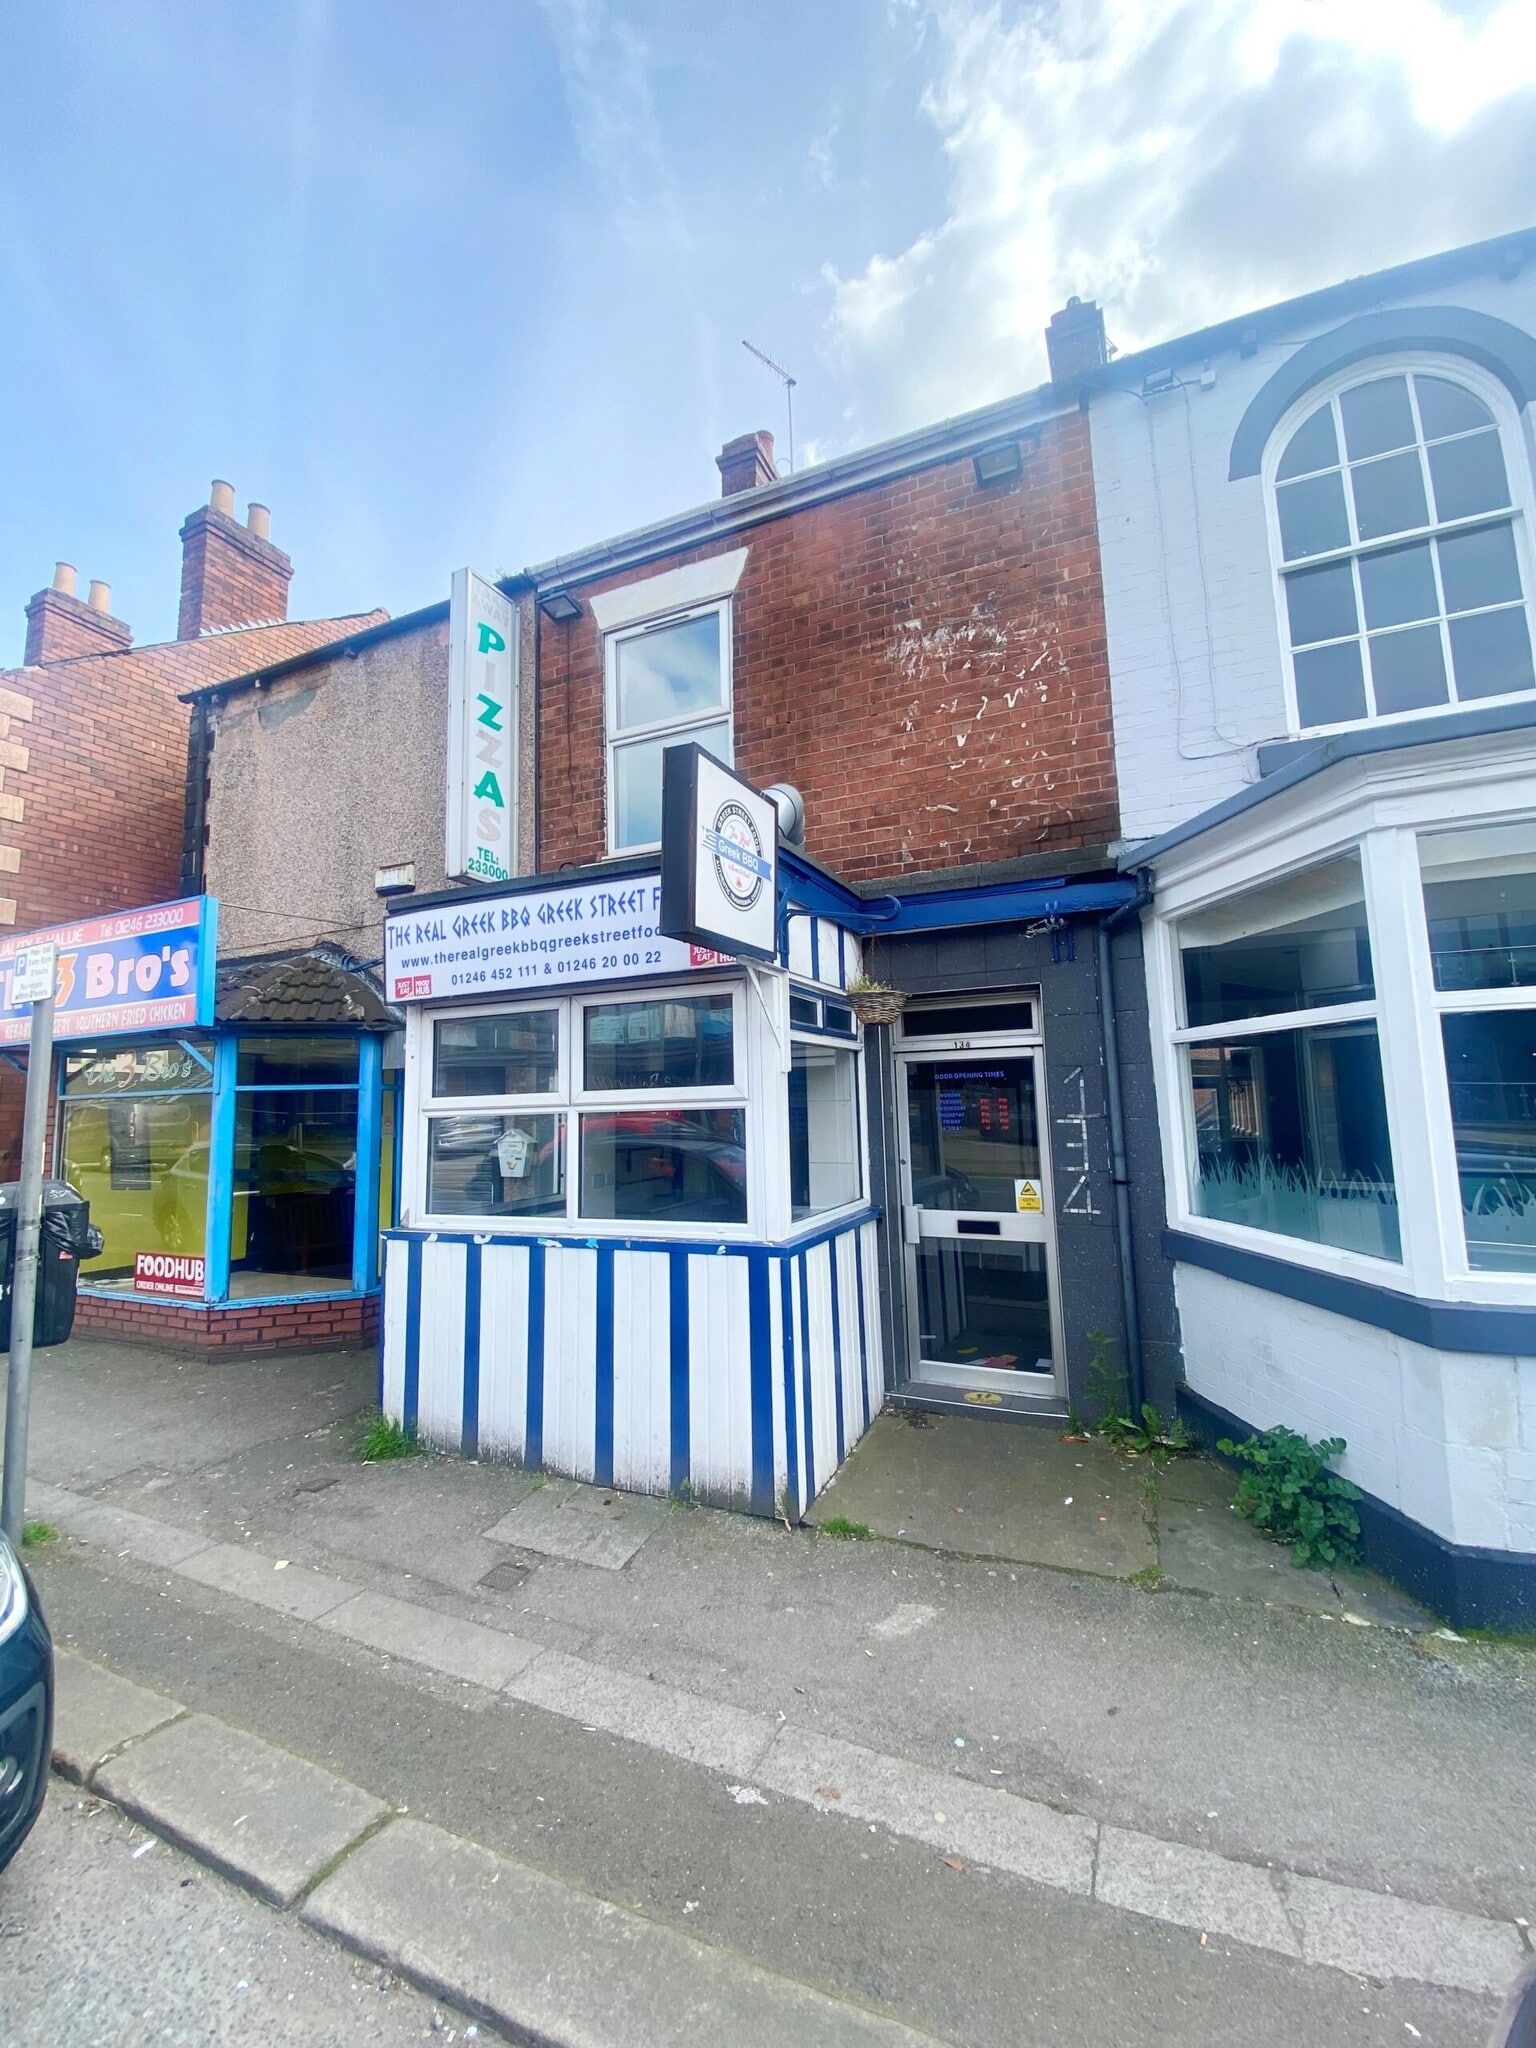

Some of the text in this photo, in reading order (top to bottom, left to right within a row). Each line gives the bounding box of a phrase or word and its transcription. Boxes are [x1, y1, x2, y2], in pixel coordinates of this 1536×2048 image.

[473, 621, 506, 841] PIZZAS
[477, 846, 499, 866] TEL:
[718, 839, 741, 860] Greek
[742, 852, 759, 872] BBQ
[468, 857, 508, 880] 233000
[145, 907, 184, 929] 233000
[387, 925, 411, 950] THE
[416, 919, 447, 944] REAL
[452, 910, 496, 940] GREEK
[501, 905, 531, 931] BBQ
[537, 898, 583, 925] GREEK
[590, 888, 645, 918] STREET
[451, 950, 661, 985] 01246 452 111 & 01246 20 00 22
[696, 953, 711, 962] EAT
[85, 945, 190, 999] Bro's
[121, 1007, 147, 1027] FRIED
[150, 1002, 187, 1022] CHICKEN
[935, 1070, 1005, 1080] DOOR OPENING TIMES
[136, 1253, 205, 1282] FOODHUB
[136, 1280, 154, 1291] ORDER
[155, 1281, 175, 1293] ONLINE
